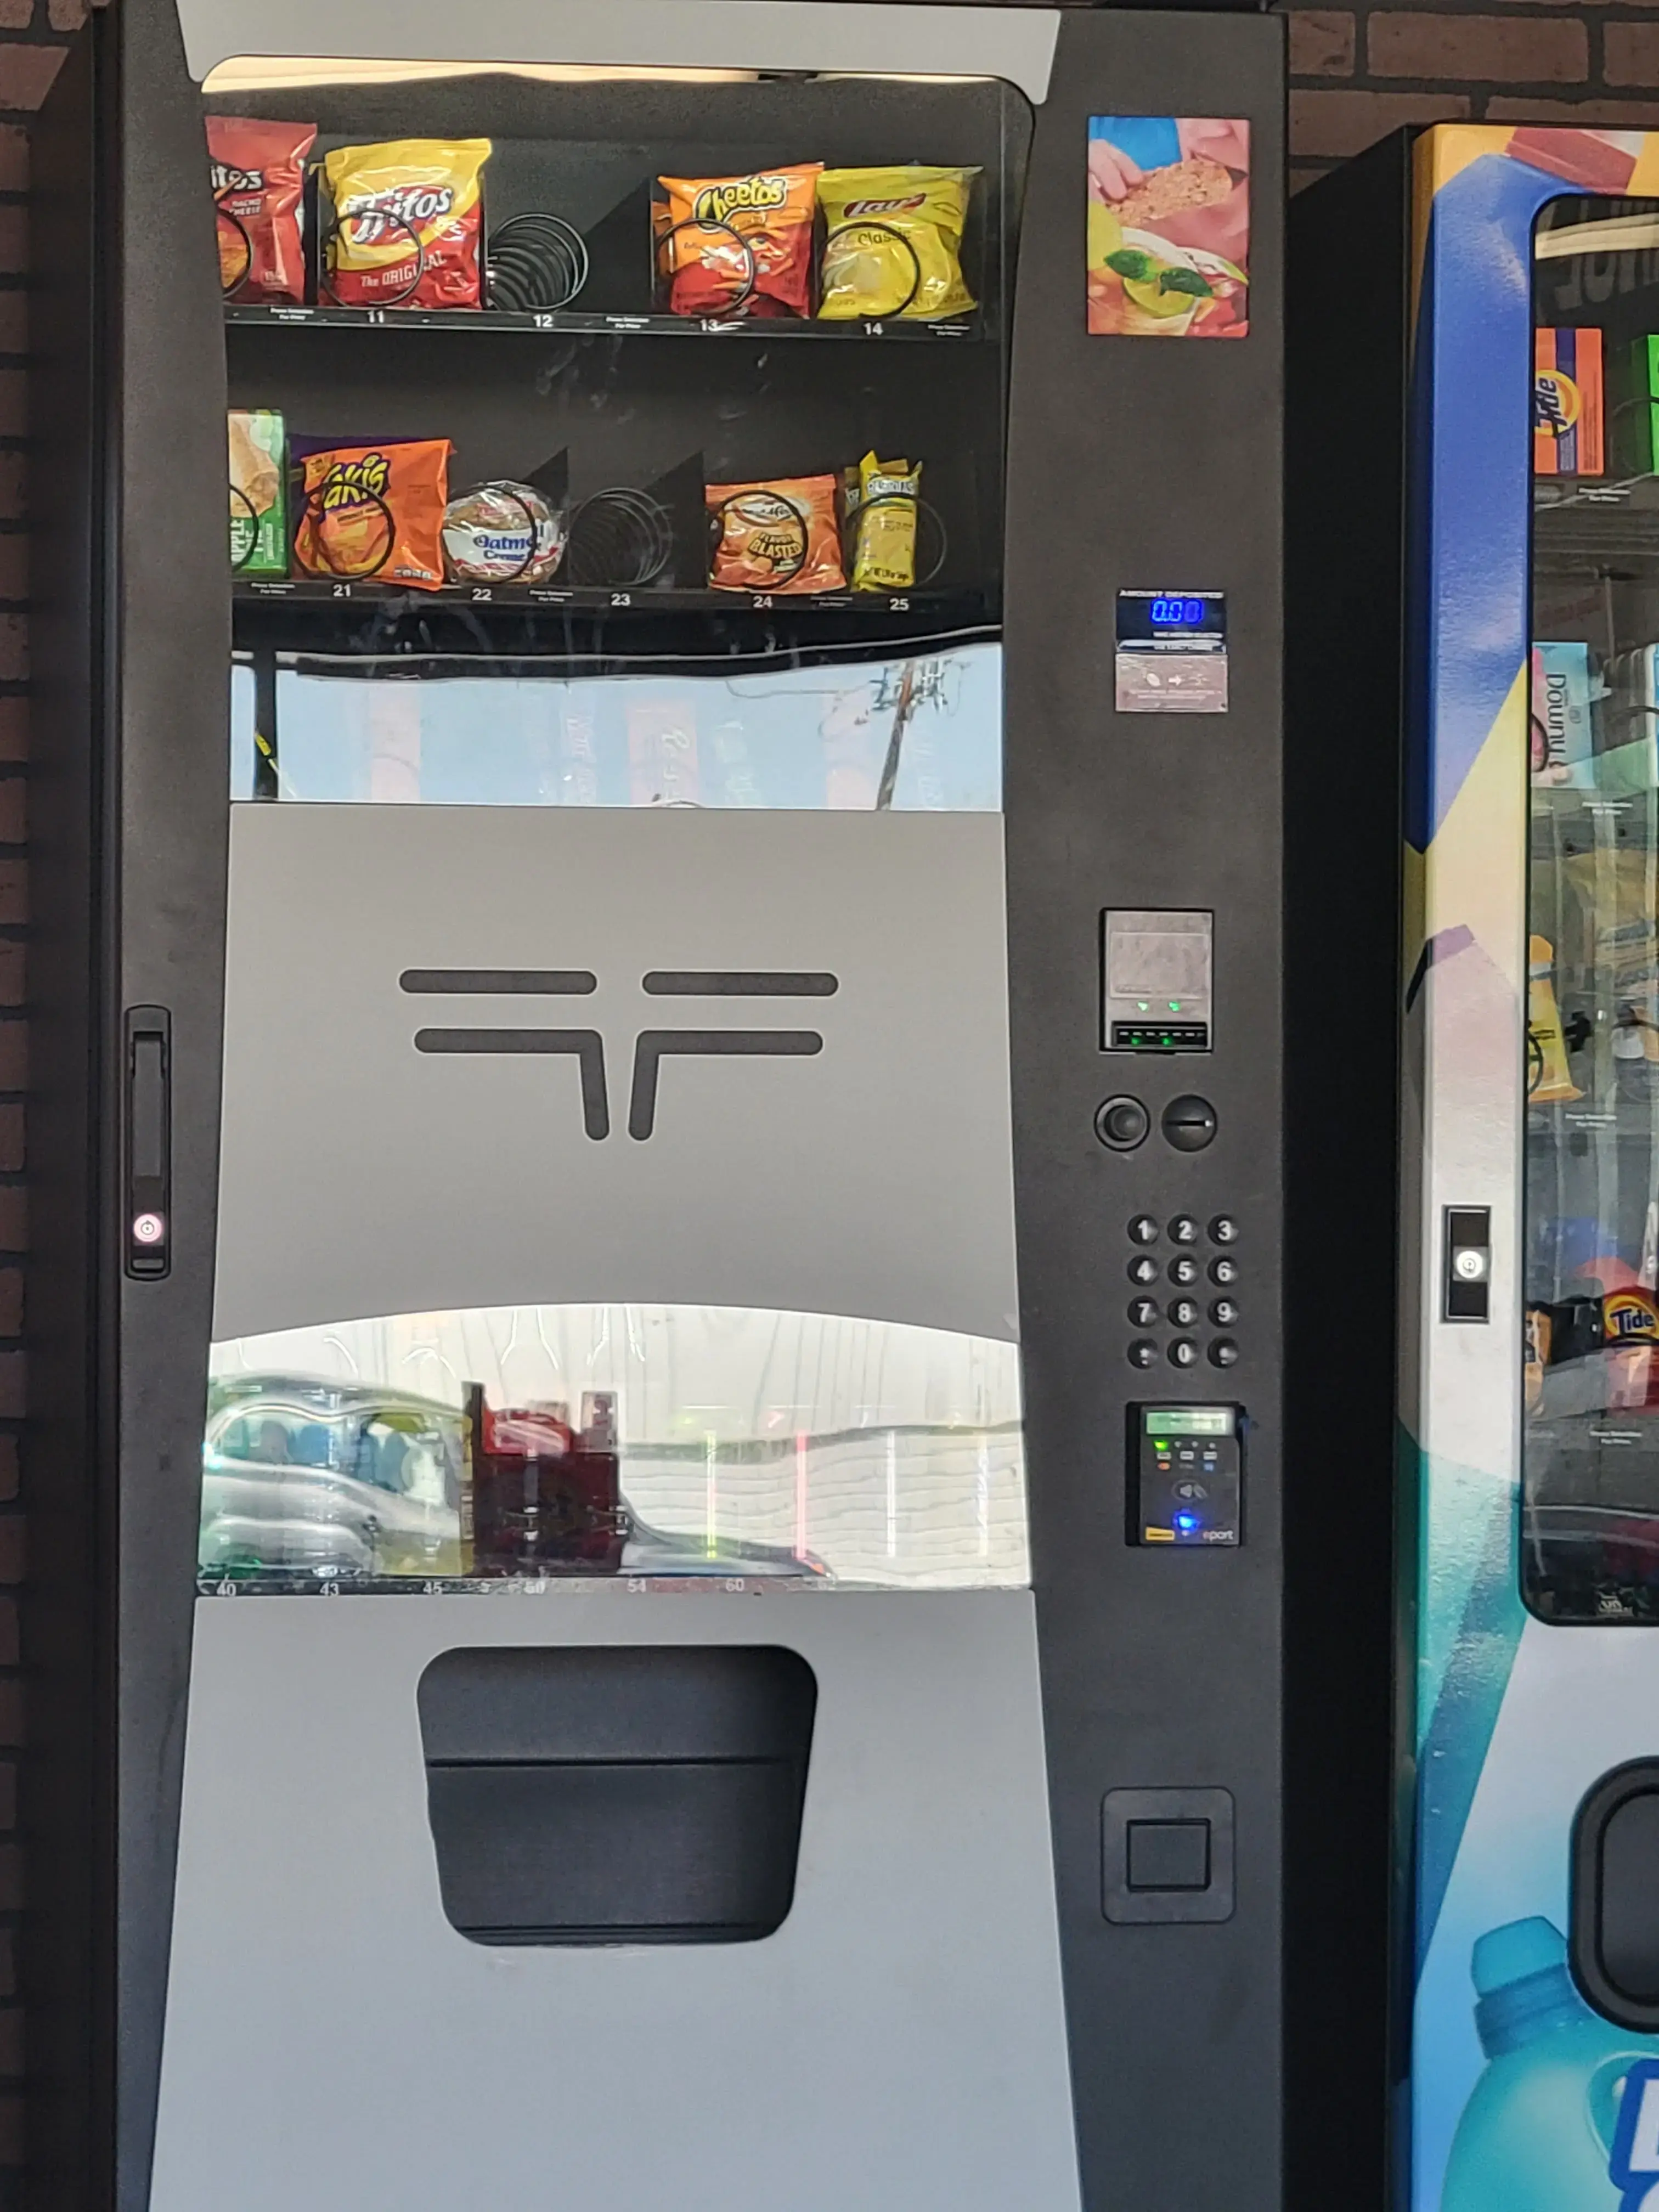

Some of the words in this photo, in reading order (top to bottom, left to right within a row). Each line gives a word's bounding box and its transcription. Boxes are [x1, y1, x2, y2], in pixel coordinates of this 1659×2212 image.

[697, 177, 786, 230] Cheetos
[367, 311, 385, 324] 11
[532, 314, 554, 328] 12
[699, 318, 721, 332] 13
[864, 323, 884, 335] 14
[749, 539, 802, 558] BLASTED
[333, 584, 351, 597] 21
[472, 589, 492, 601] 22
[611, 592, 631, 606] 23
[753, 596, 773, 608] 24
[889, 599, 910, 611] 25
[1545, 674, 1566, 754] Downy
[1138, 1220, 1148, 1240] 1
[1178, 1220, 1192, 1239] 2
[1217, 1220, 1232, 1240] 3
[1137, 1260, 1151, 1281] 4
[1178, 1261, 1191, 1281] 5
[1217, 1261, 1232, 1282] 6
[1137, 1302, 1151, 1323] 7
[1178, 1302, 1191, 1323] 8
[1217, 1302, 1232, 1322] 9
[1610, 1308, 1655, 1337] Tide
[1177, 1343, 1190, 1364] 0
[217, 1581, 236, 1596] 40
[319, 1582, 340, 1596] 43
[423, 1581, 443, 1594] 45
[726, 1578, 744, 1592] 60
